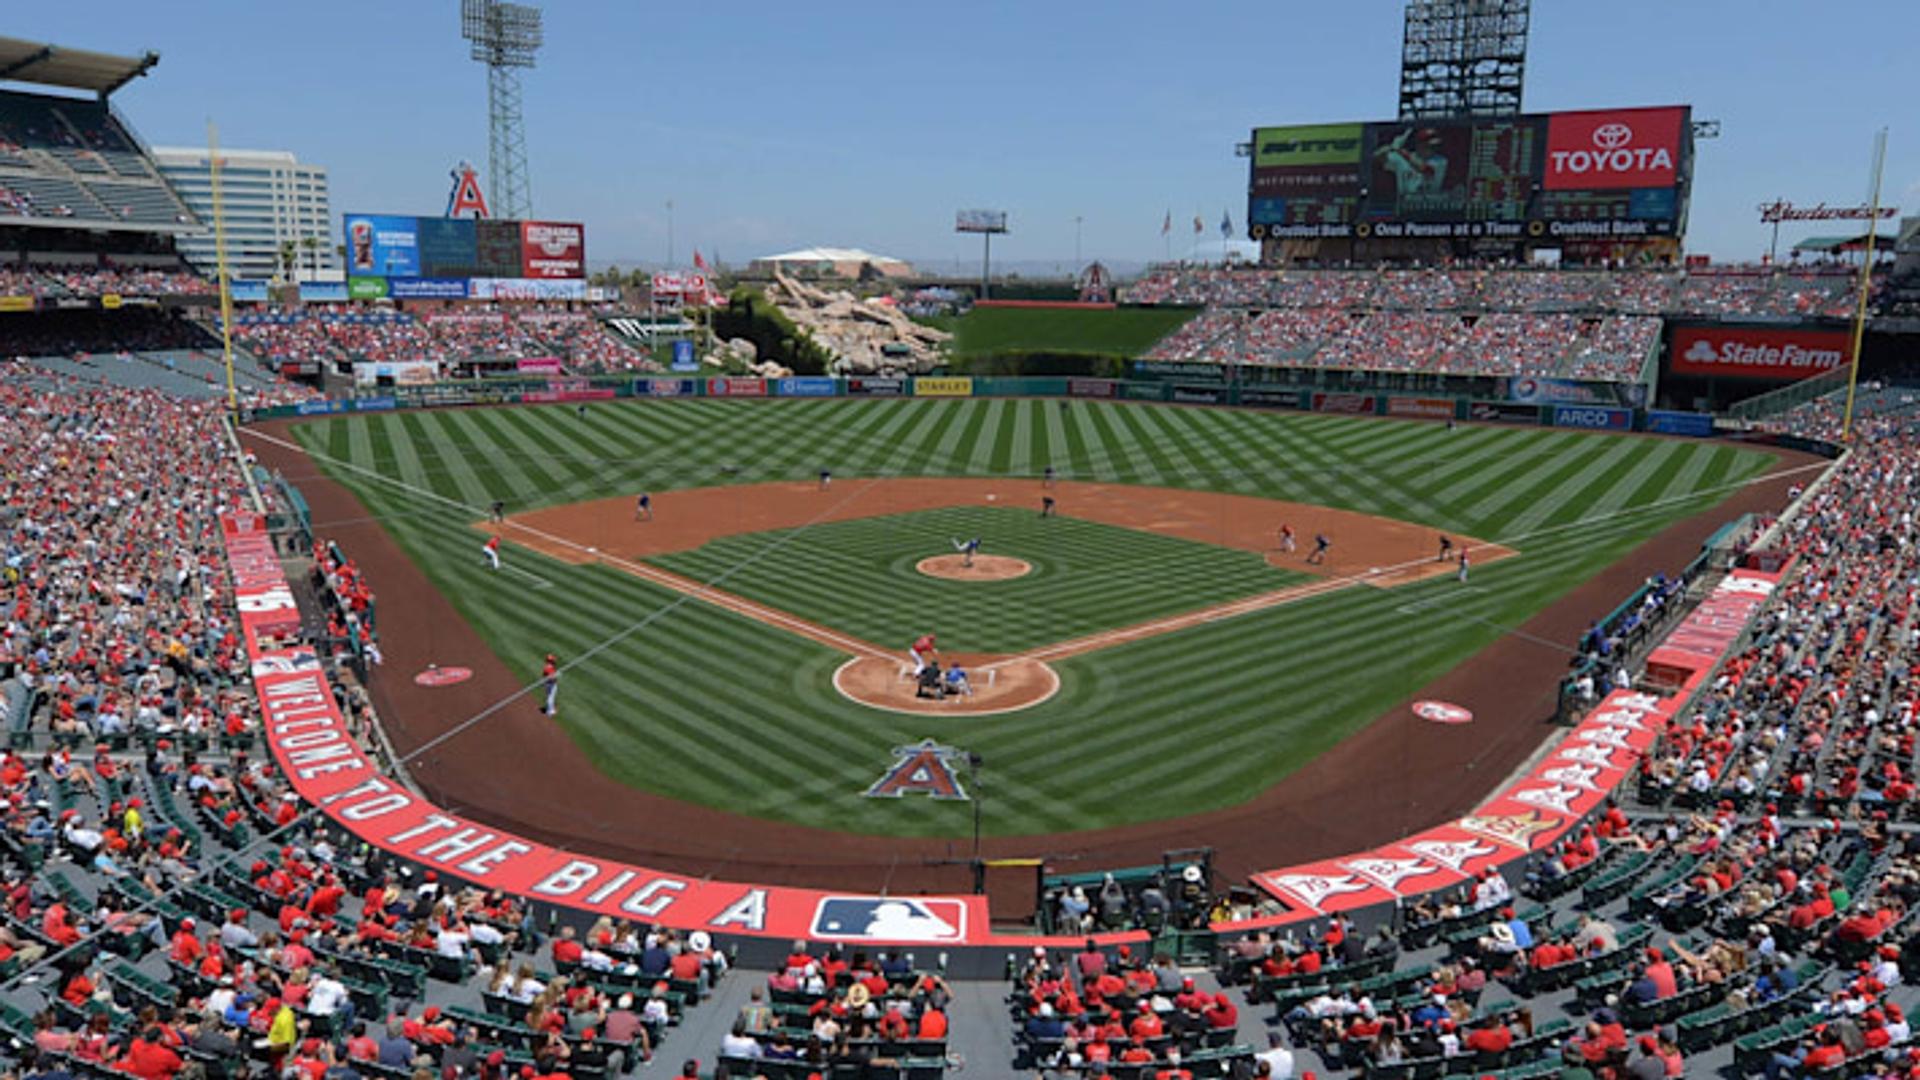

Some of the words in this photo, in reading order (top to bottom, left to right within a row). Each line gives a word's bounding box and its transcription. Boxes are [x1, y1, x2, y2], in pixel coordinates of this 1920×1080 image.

[1551, 147, 1673, 174] TOYOTA
[1320, 223, 1350, 236] Bank
[1375, 222, 1403, 236] One
[1405, 222, 1451, 236] Person
[1453, 222, 1468, 235] at
[1471, 224, 1481, 235] a
[1485, 221, 1522, 235] Time
[1550, 221, 1609, 235] OneWest
[1612, 220, 1647, 234] Bank
[1558, 408, 1609, 425] ARCO
[264, 674, 365, 780] WELCOME
[319, 777, 412, 821] TO
[386, 812, 534, 876] THE
[531, 859, 688, 917] BIG
[708, 887, 769, 931] A
